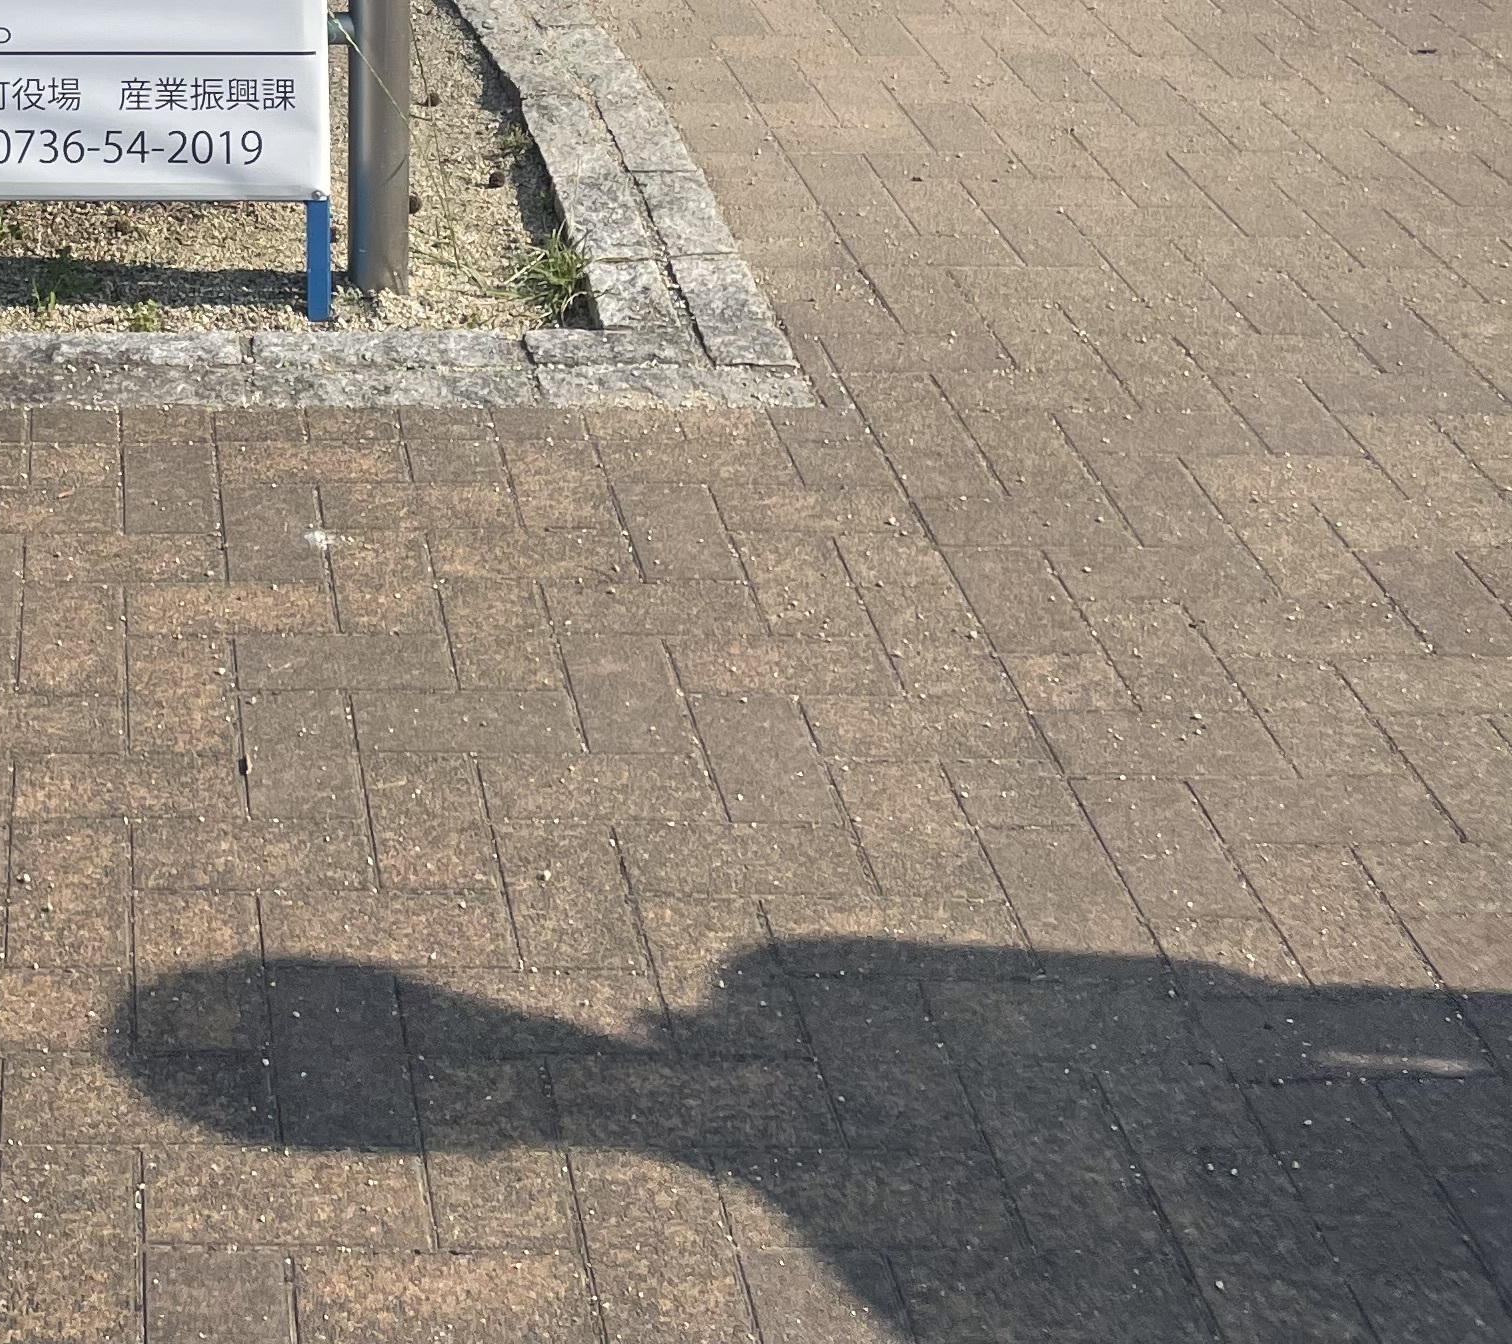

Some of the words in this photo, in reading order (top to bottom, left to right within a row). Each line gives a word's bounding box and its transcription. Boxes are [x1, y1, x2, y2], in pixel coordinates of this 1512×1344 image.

[120, 77, 295, 111] 産業振興課
